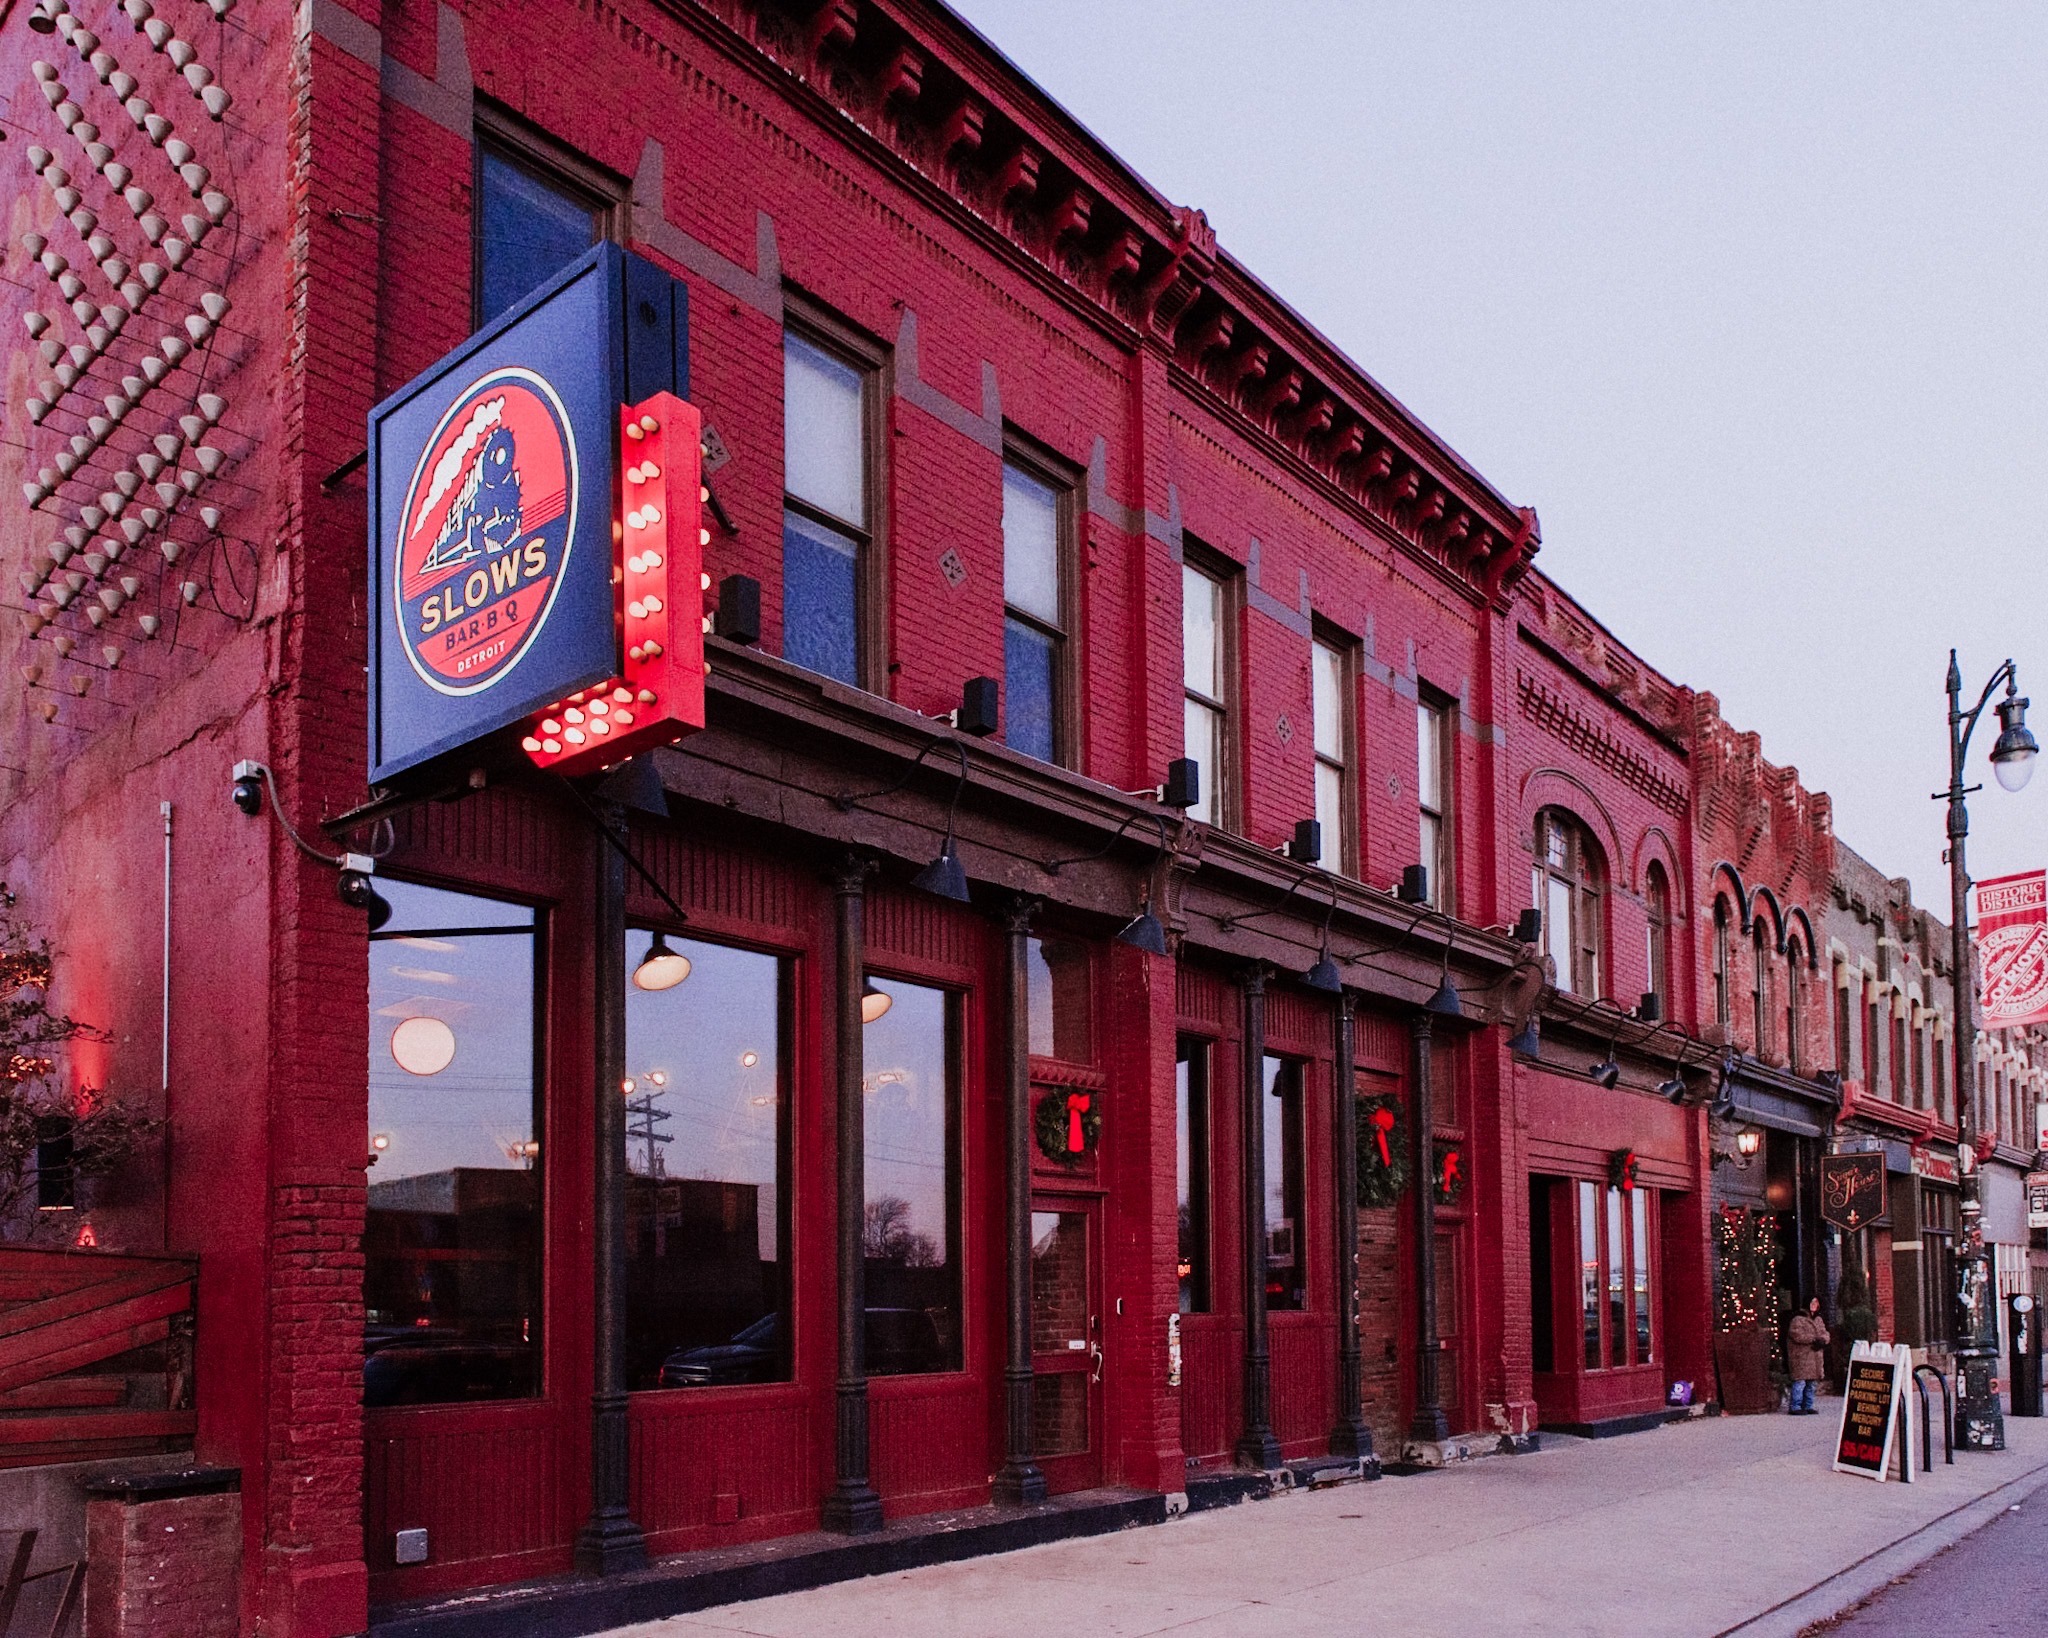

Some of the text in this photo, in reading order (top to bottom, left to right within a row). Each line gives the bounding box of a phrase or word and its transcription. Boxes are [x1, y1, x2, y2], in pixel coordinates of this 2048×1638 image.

[420, 538, 547, 633] SLOWS
[457, 639, 506, 674] DETROIT
[1981, 882, 2043, 903] HISTORIC
[1982, 891, 2043, 911] DISTRICT
[1981, 931, 2048, 1014] Corktown
[1830, 1168, 1881, 1208] House
[1860, 1368, 1885, 1380] SECURE
[1852, 1379, 1890, 1393] COMMUNITY
[1849, 1390, 1890, 1404] PARKING LOT
[1857, 1402, 1880, 1414] BEHIND
[1851, 1412, 1883, 1426] MERCURY
[1858, 1425, 1872, 1437] BAR
